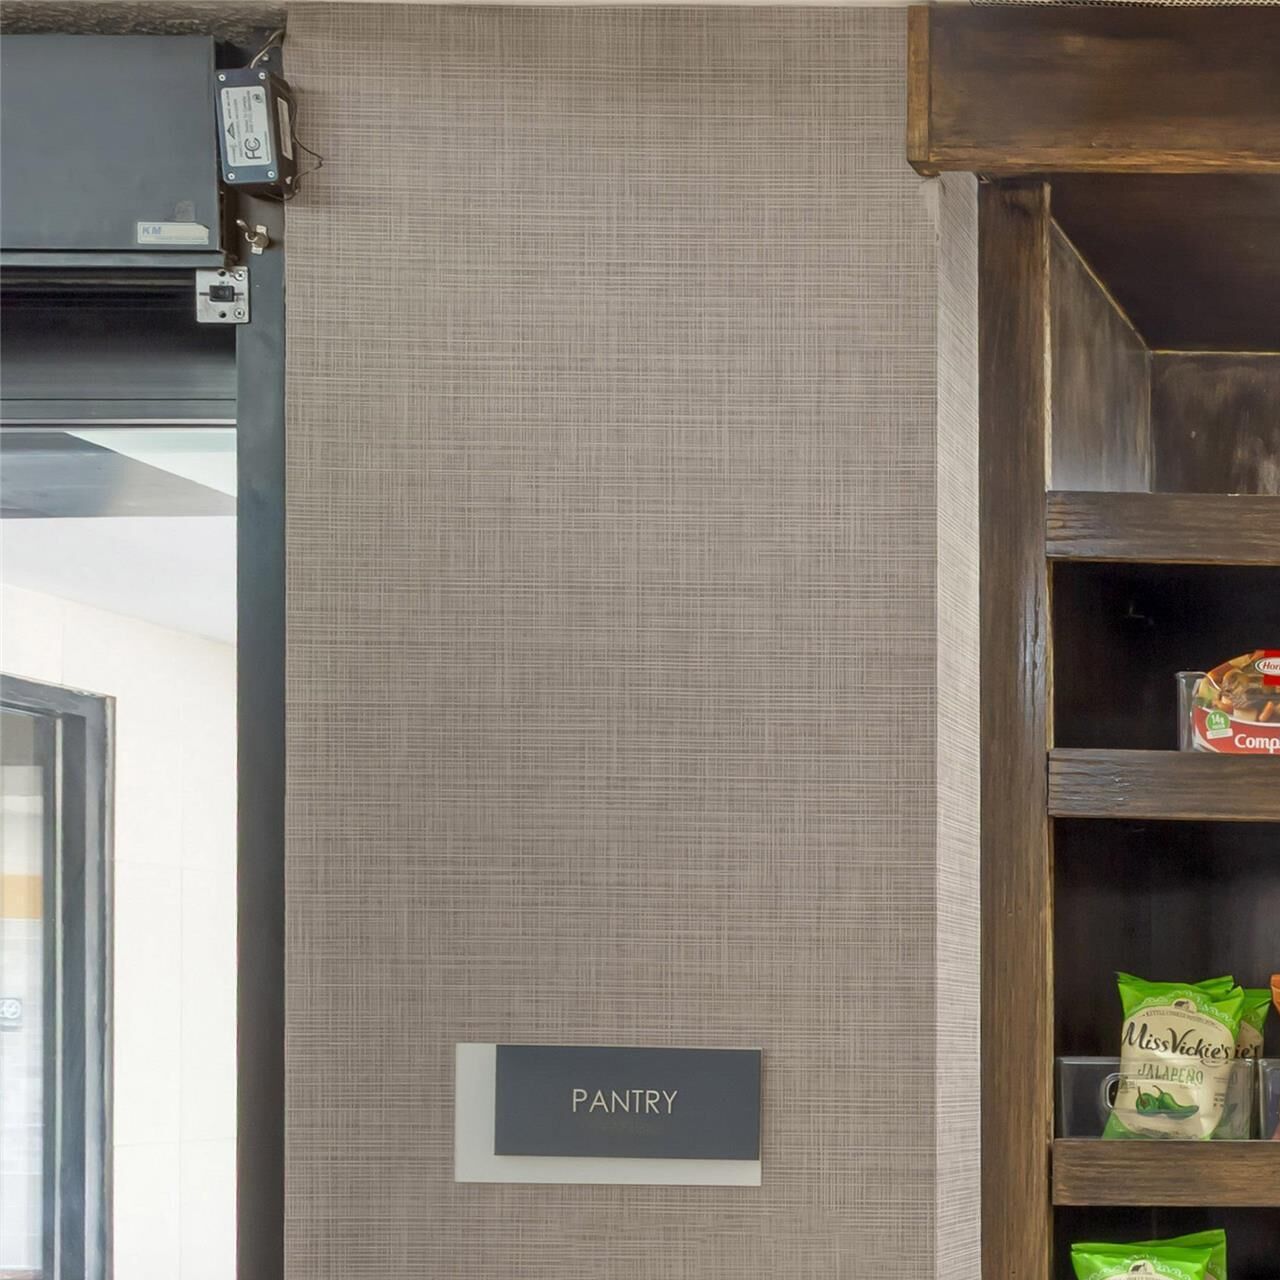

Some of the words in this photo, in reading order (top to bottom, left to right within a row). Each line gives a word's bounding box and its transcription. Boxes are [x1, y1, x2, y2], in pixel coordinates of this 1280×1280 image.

[1121, 1021, 1169, 1051] Miss
[1167, 1027, 1231, 1064] Vickie's
[571, 1088, 678, 1114] PANTRY
